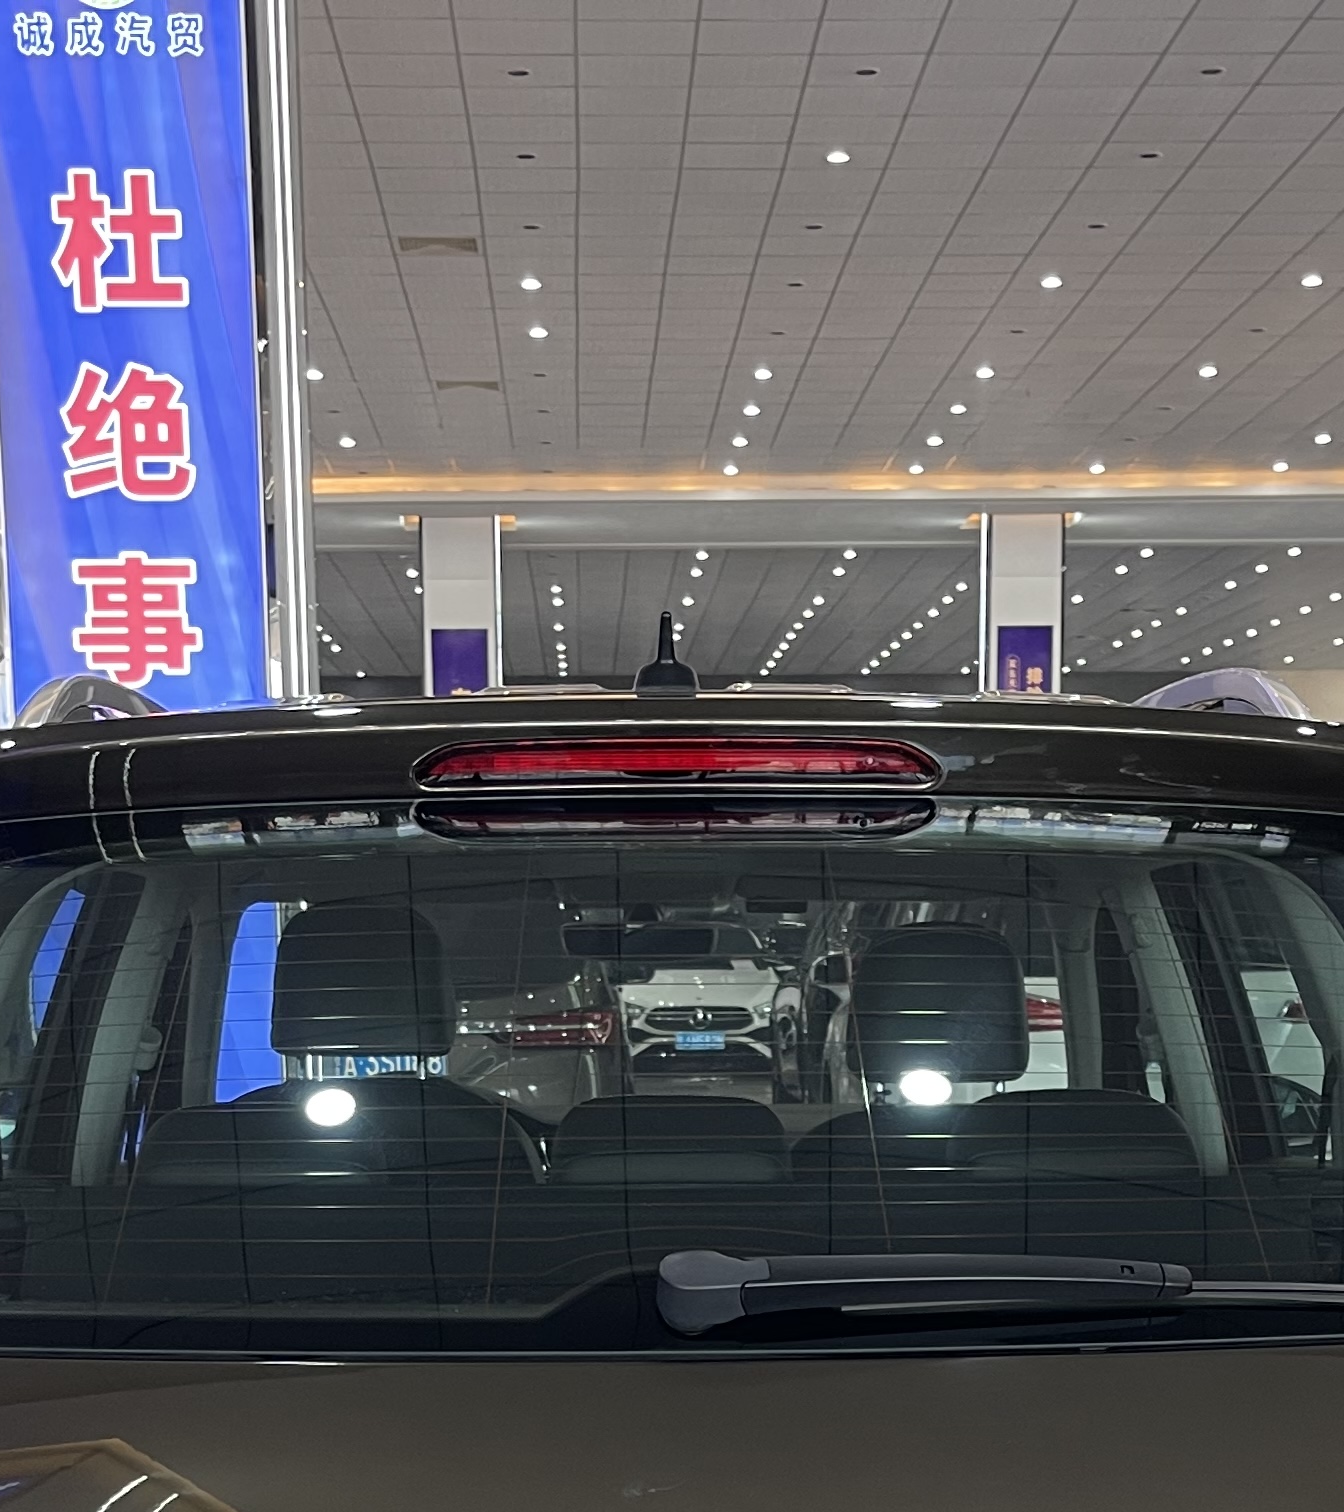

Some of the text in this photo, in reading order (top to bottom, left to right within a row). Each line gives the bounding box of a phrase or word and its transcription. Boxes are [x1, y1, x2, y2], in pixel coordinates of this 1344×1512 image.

[13, 12, 205, 57] 诚成汽贸
[51, 168, 203, 689] 杜绝事
